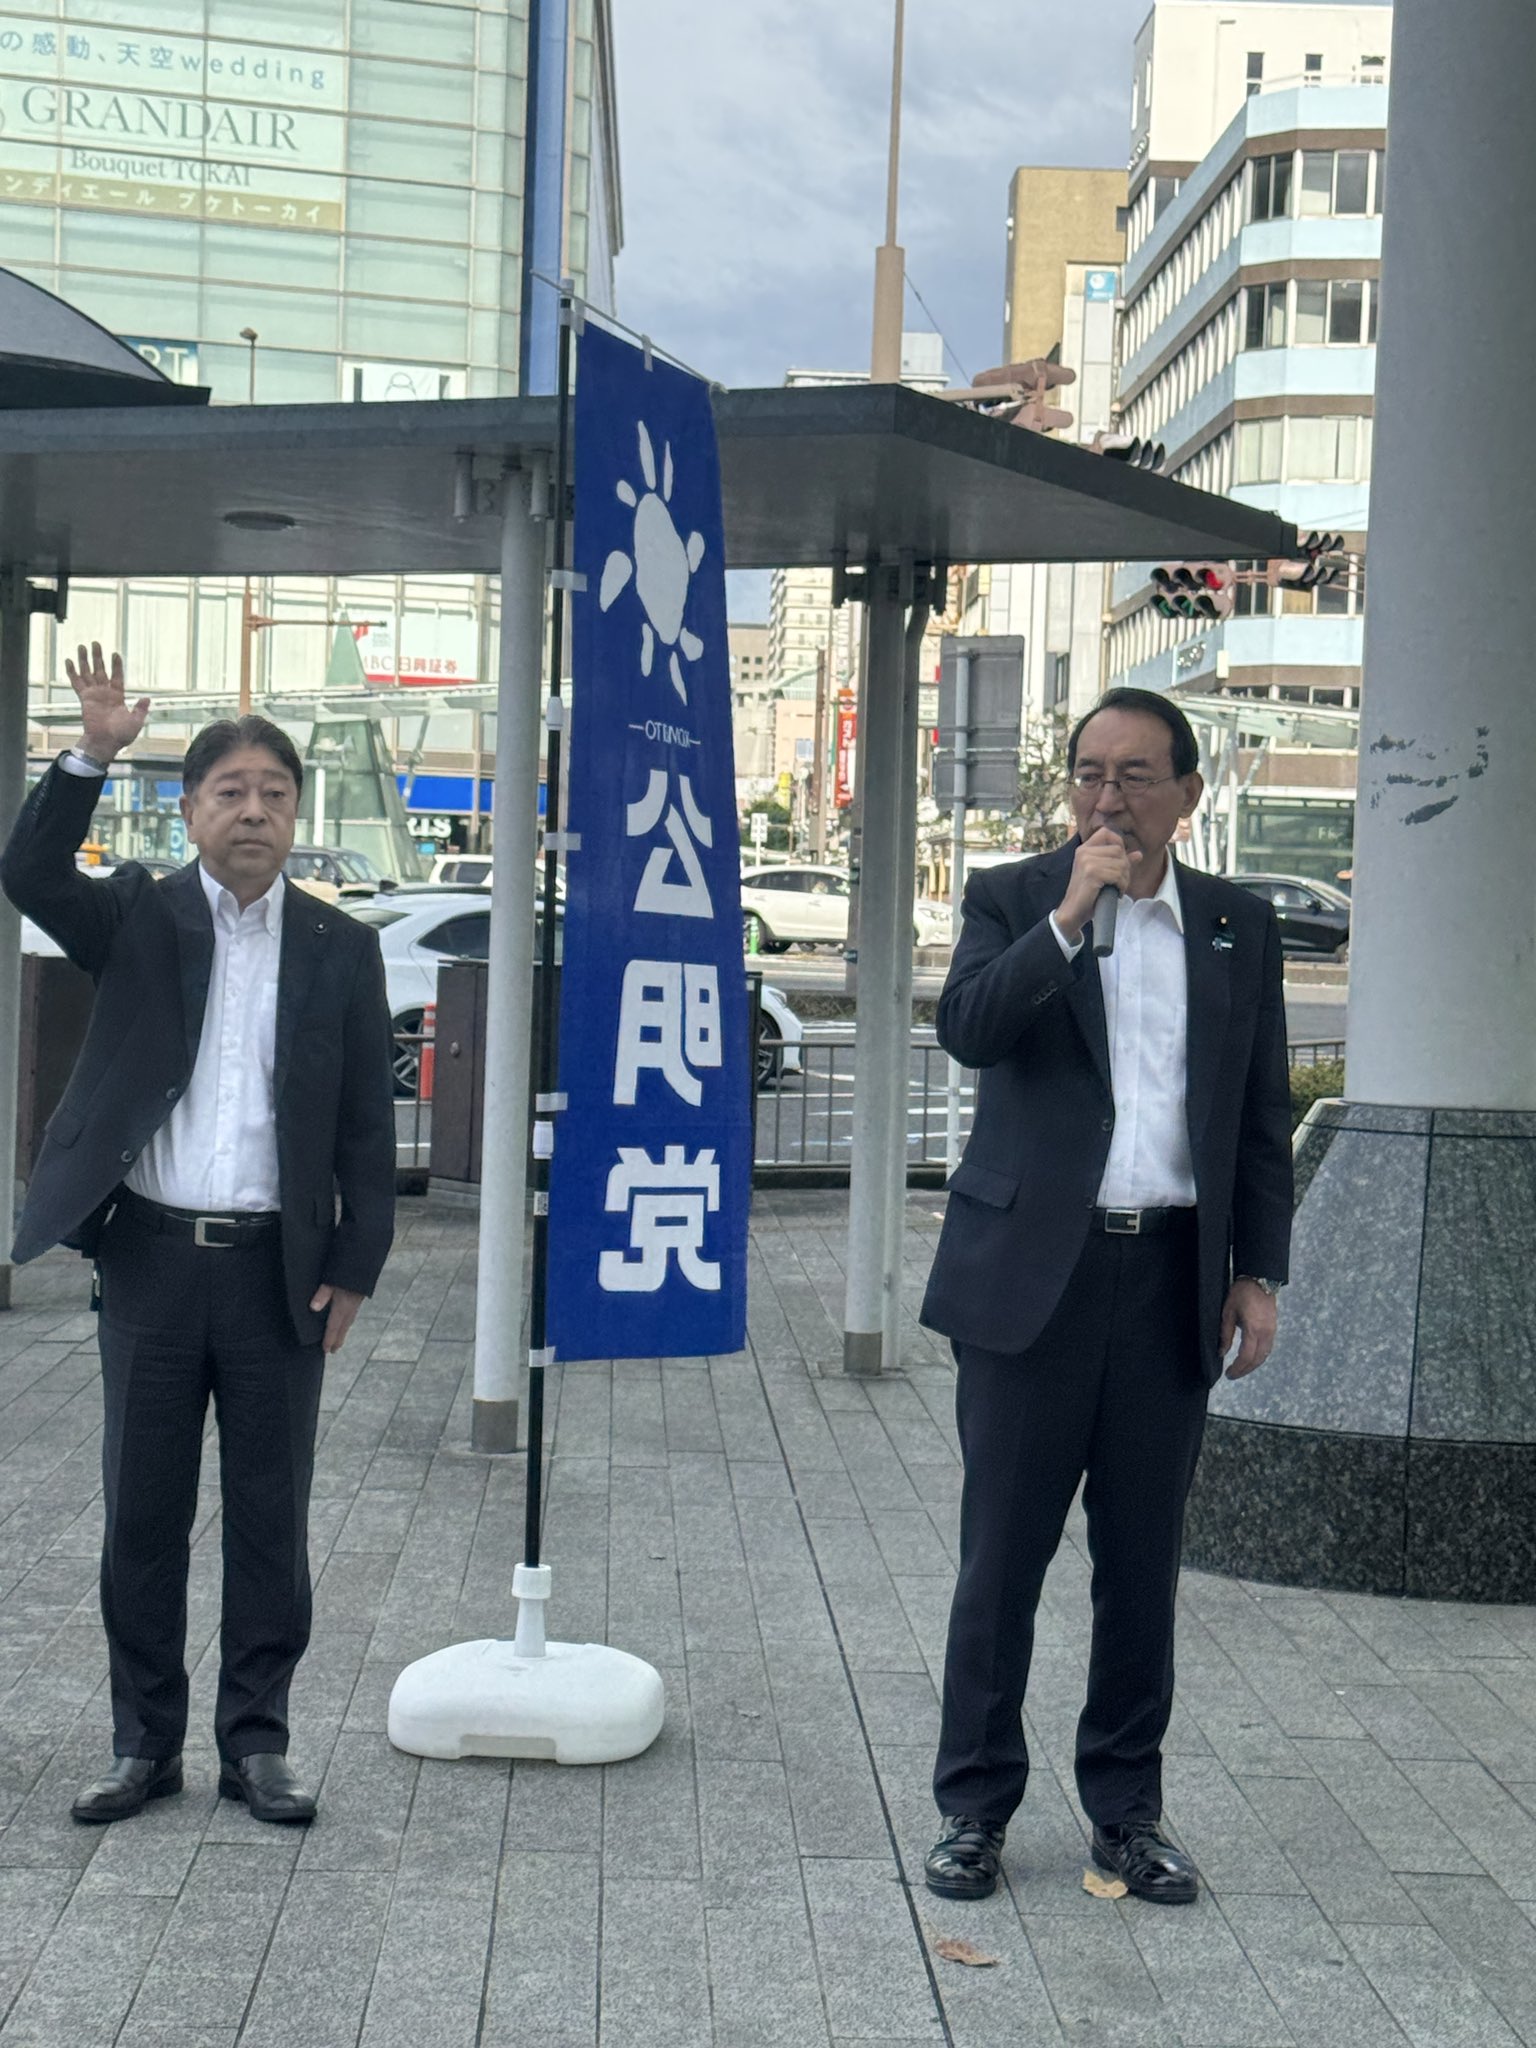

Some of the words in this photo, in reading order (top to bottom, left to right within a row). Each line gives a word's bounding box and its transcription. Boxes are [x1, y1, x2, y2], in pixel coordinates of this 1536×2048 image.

[22, 86, 301, 152] GRANDAIR
[71, 149, 165, 181] Bouquet
[174, 160, 251, 187] TOKAI
